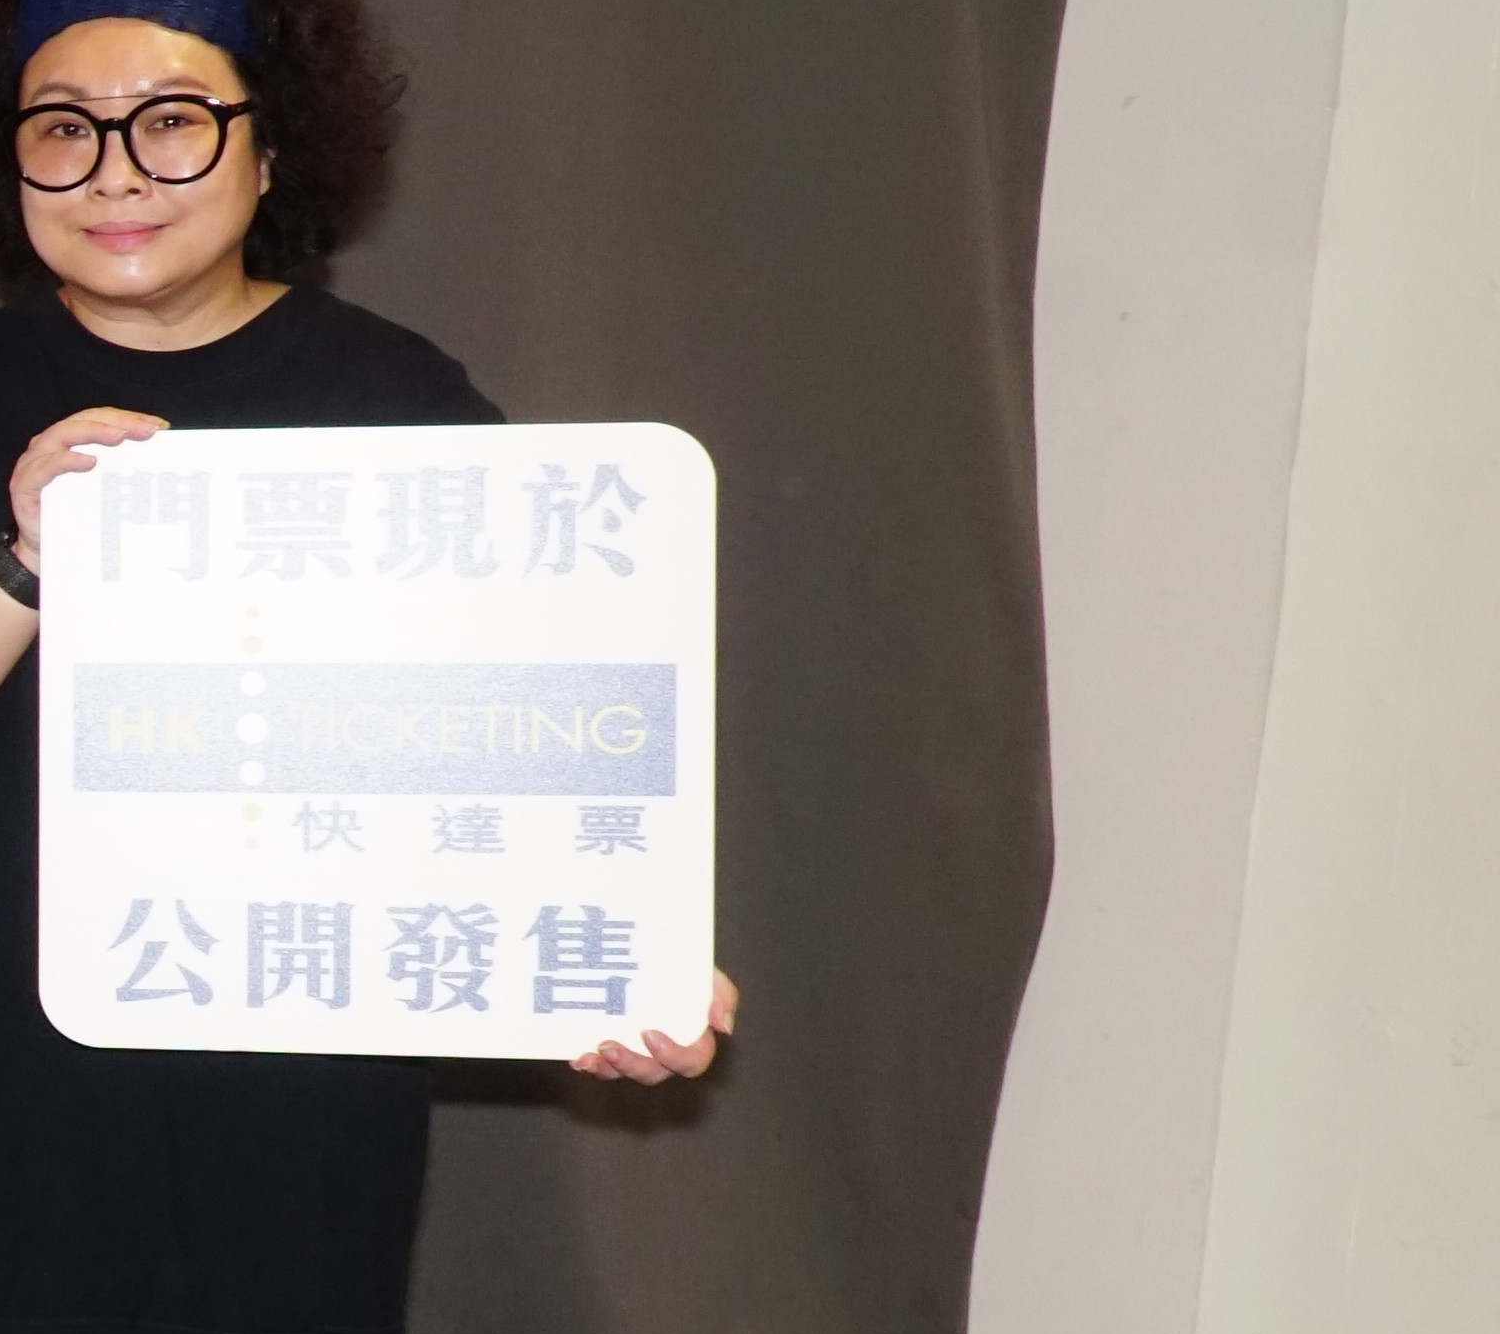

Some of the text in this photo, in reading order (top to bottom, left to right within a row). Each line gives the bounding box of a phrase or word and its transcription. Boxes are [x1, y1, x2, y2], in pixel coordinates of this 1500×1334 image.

[100, 463, 648, 582] 門票現於
[109, 704, 648, 756] HK TICKETING
[293, 800, 649, 856] 快達票
[108, 898, 639, 1017] 公開發售
